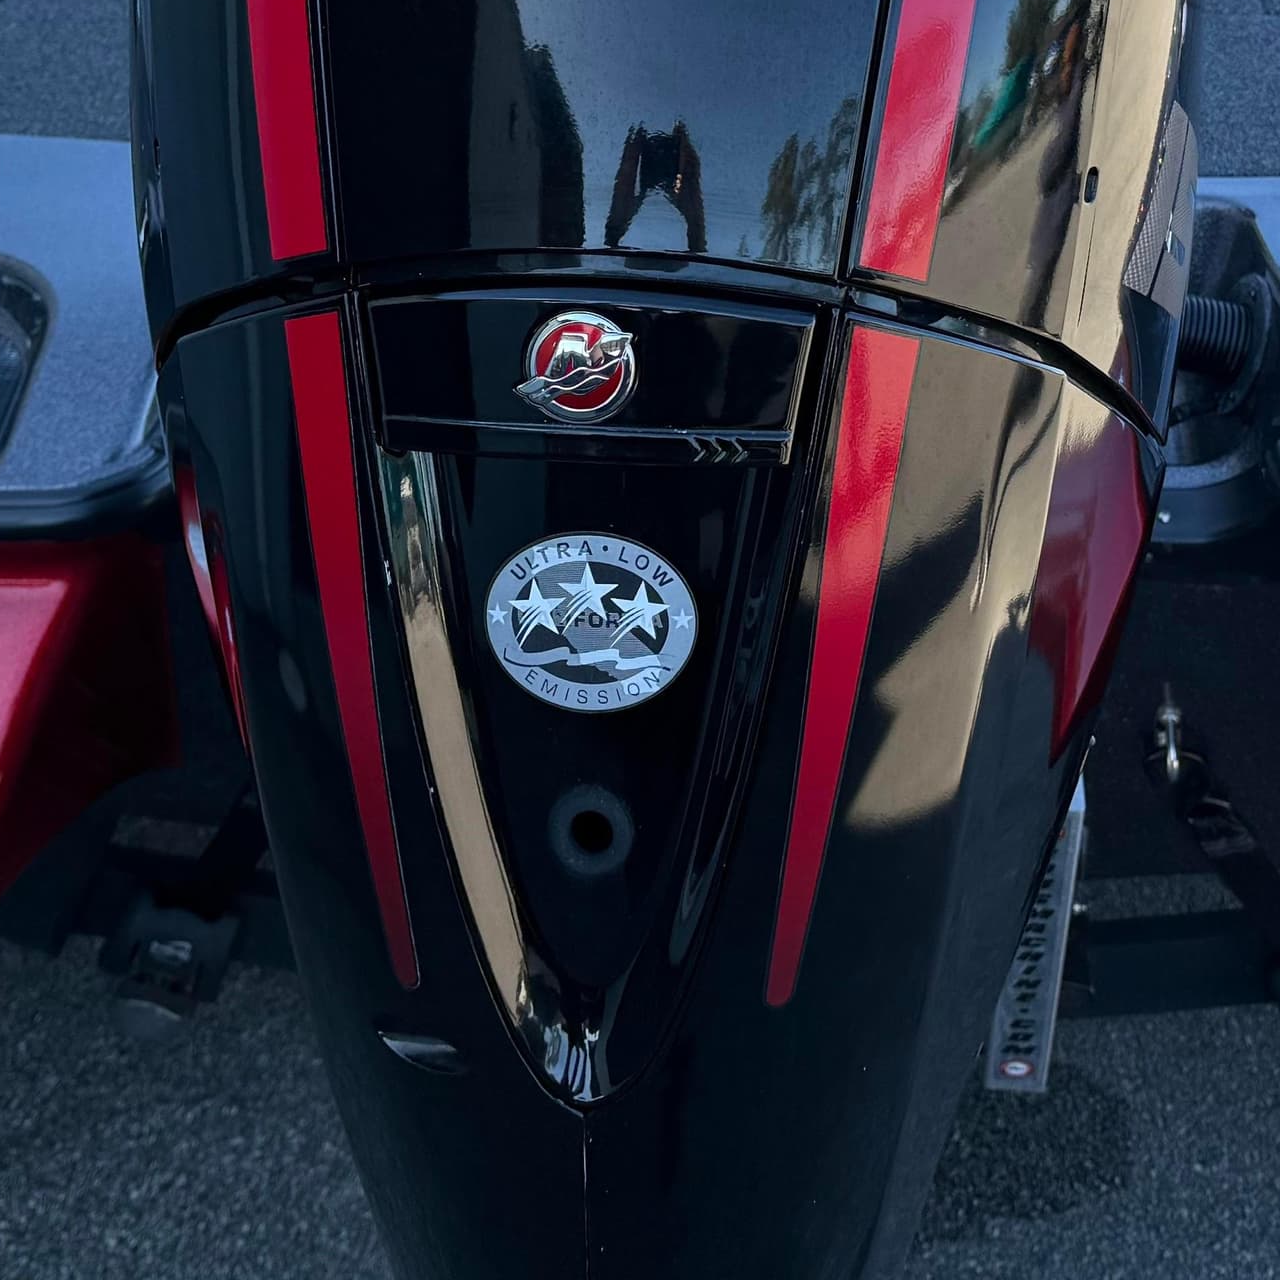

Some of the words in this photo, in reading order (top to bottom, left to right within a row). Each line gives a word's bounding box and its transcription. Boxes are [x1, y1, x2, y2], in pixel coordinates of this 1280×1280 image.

[510, 540, 593, 581] ULTRA
[618, 546, 674, 587] LOW
[524, 669, 661, 705] EMISSION
